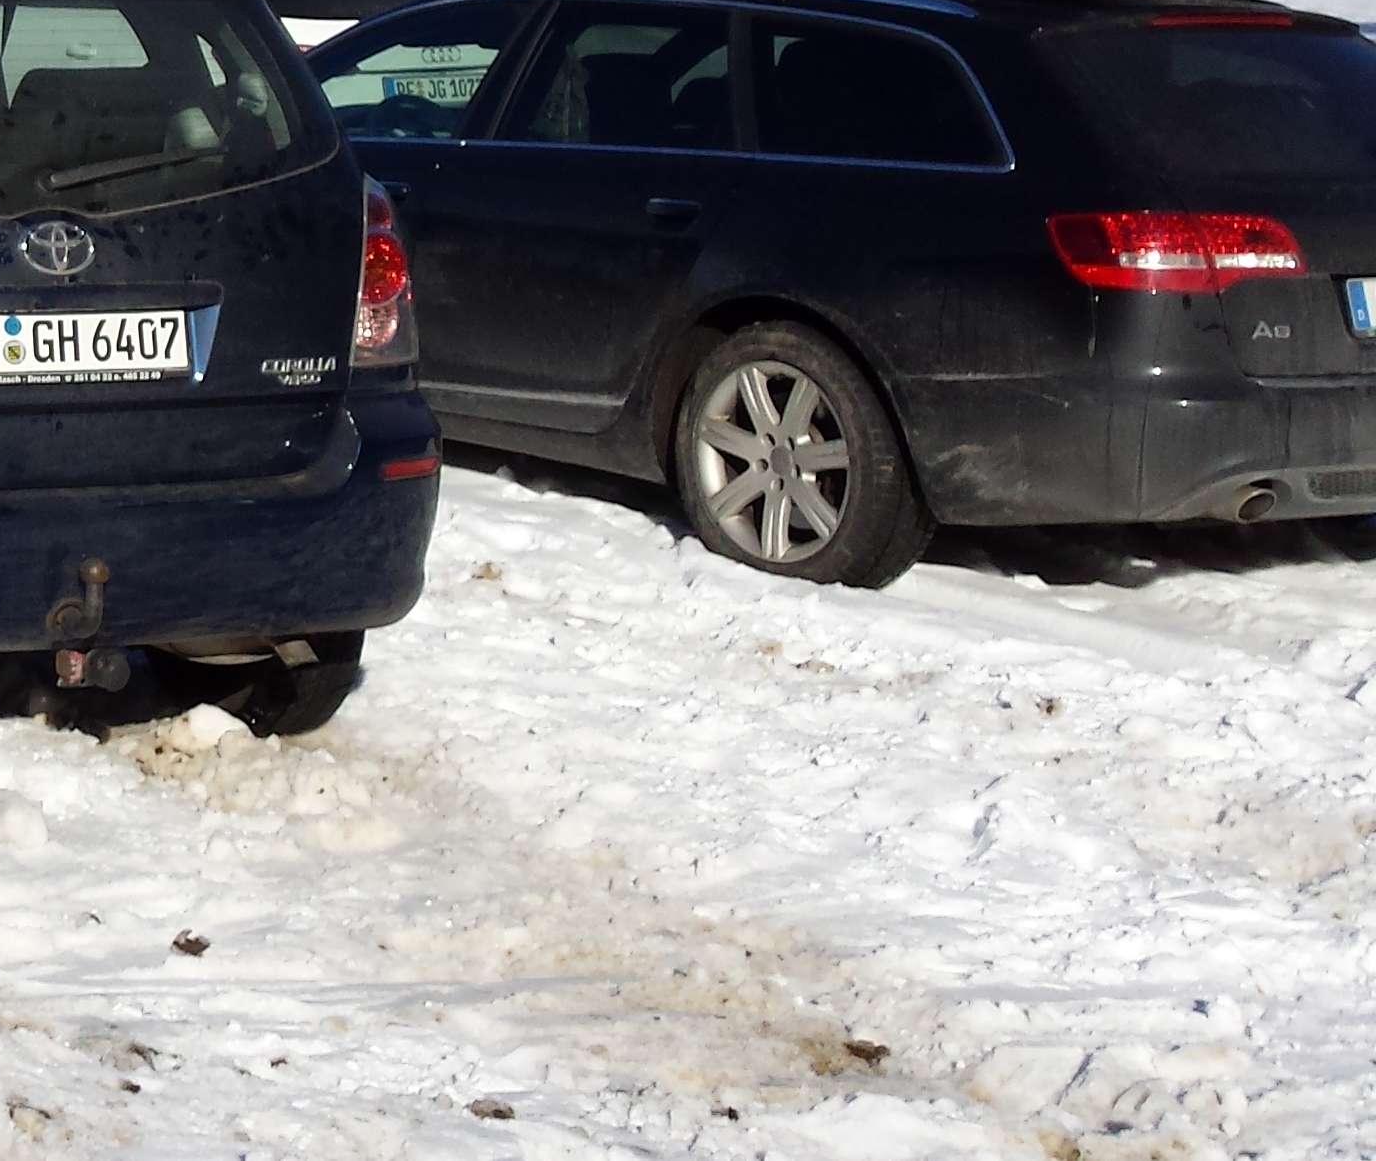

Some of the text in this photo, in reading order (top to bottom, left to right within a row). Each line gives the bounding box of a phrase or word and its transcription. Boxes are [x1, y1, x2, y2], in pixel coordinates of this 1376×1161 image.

[31, 318, 81, 364] GH
[92, 317, 180, 362] 6407
[260, 356, 337, 374] COROLLA
